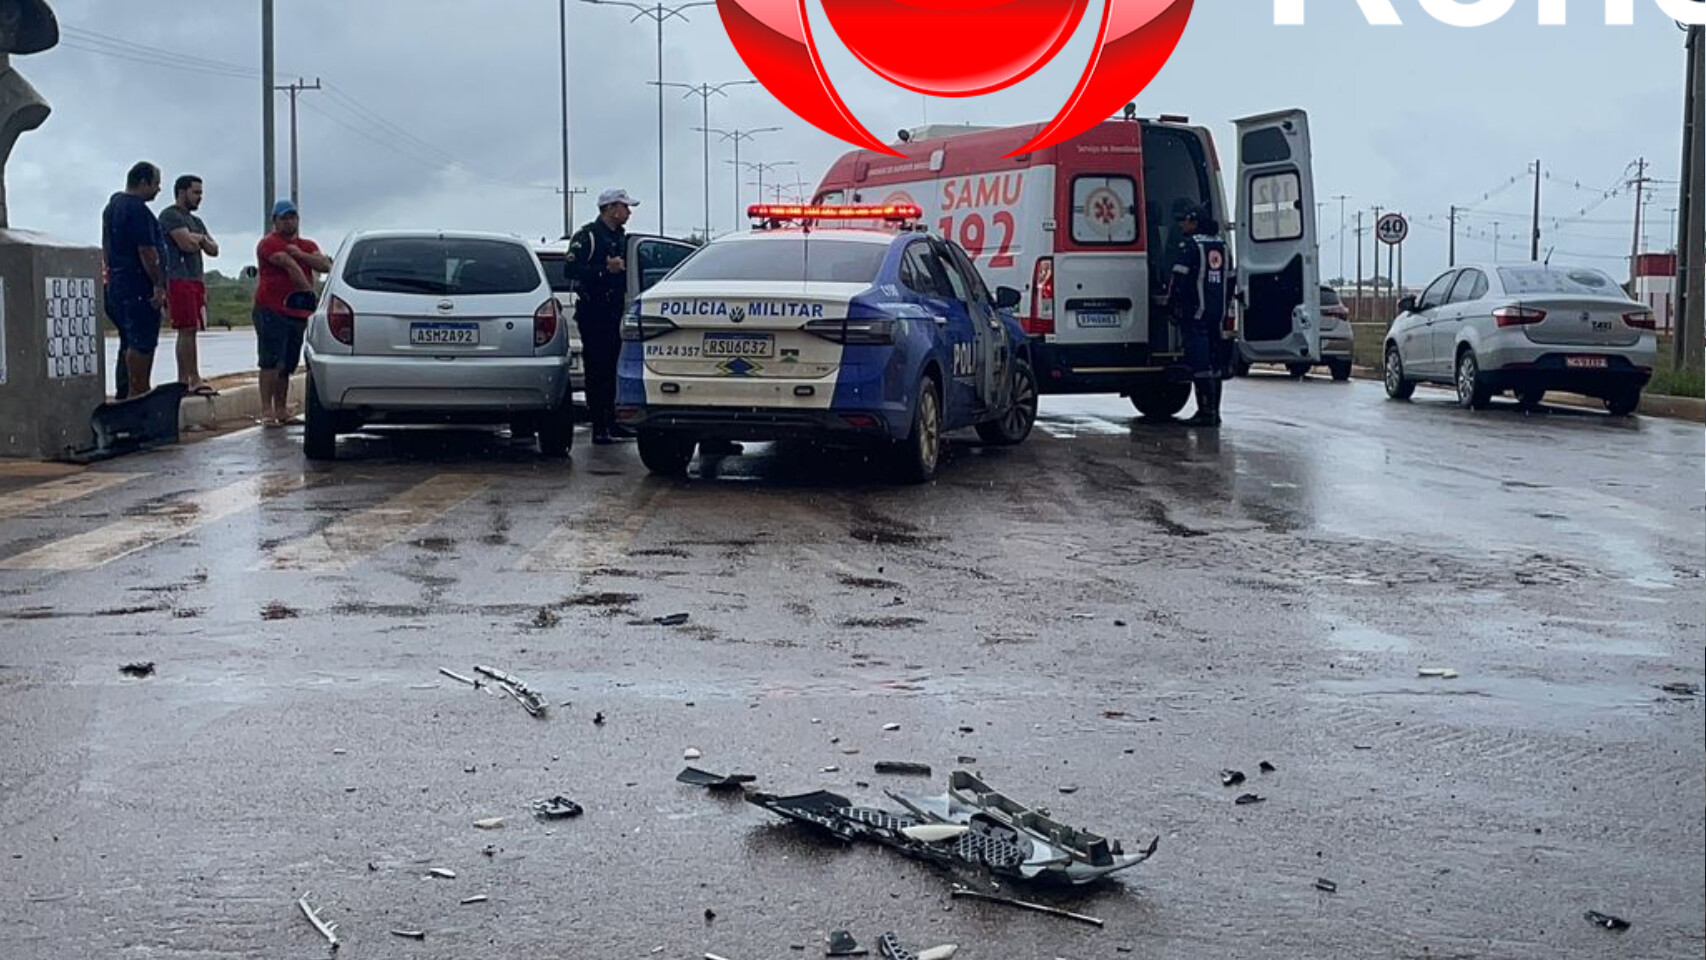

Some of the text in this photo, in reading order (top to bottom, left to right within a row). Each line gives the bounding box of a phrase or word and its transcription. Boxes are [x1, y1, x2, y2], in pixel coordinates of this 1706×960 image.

[941, 172, 1023, 211] SAMU
[1380, 219, 1402, 234] 40
[660, 298, 824, 318] POLÍCIA MILITAR
[646, 345, 700, 357] RPL 24 357
[709, 340, 768, 355] RSU6C32
